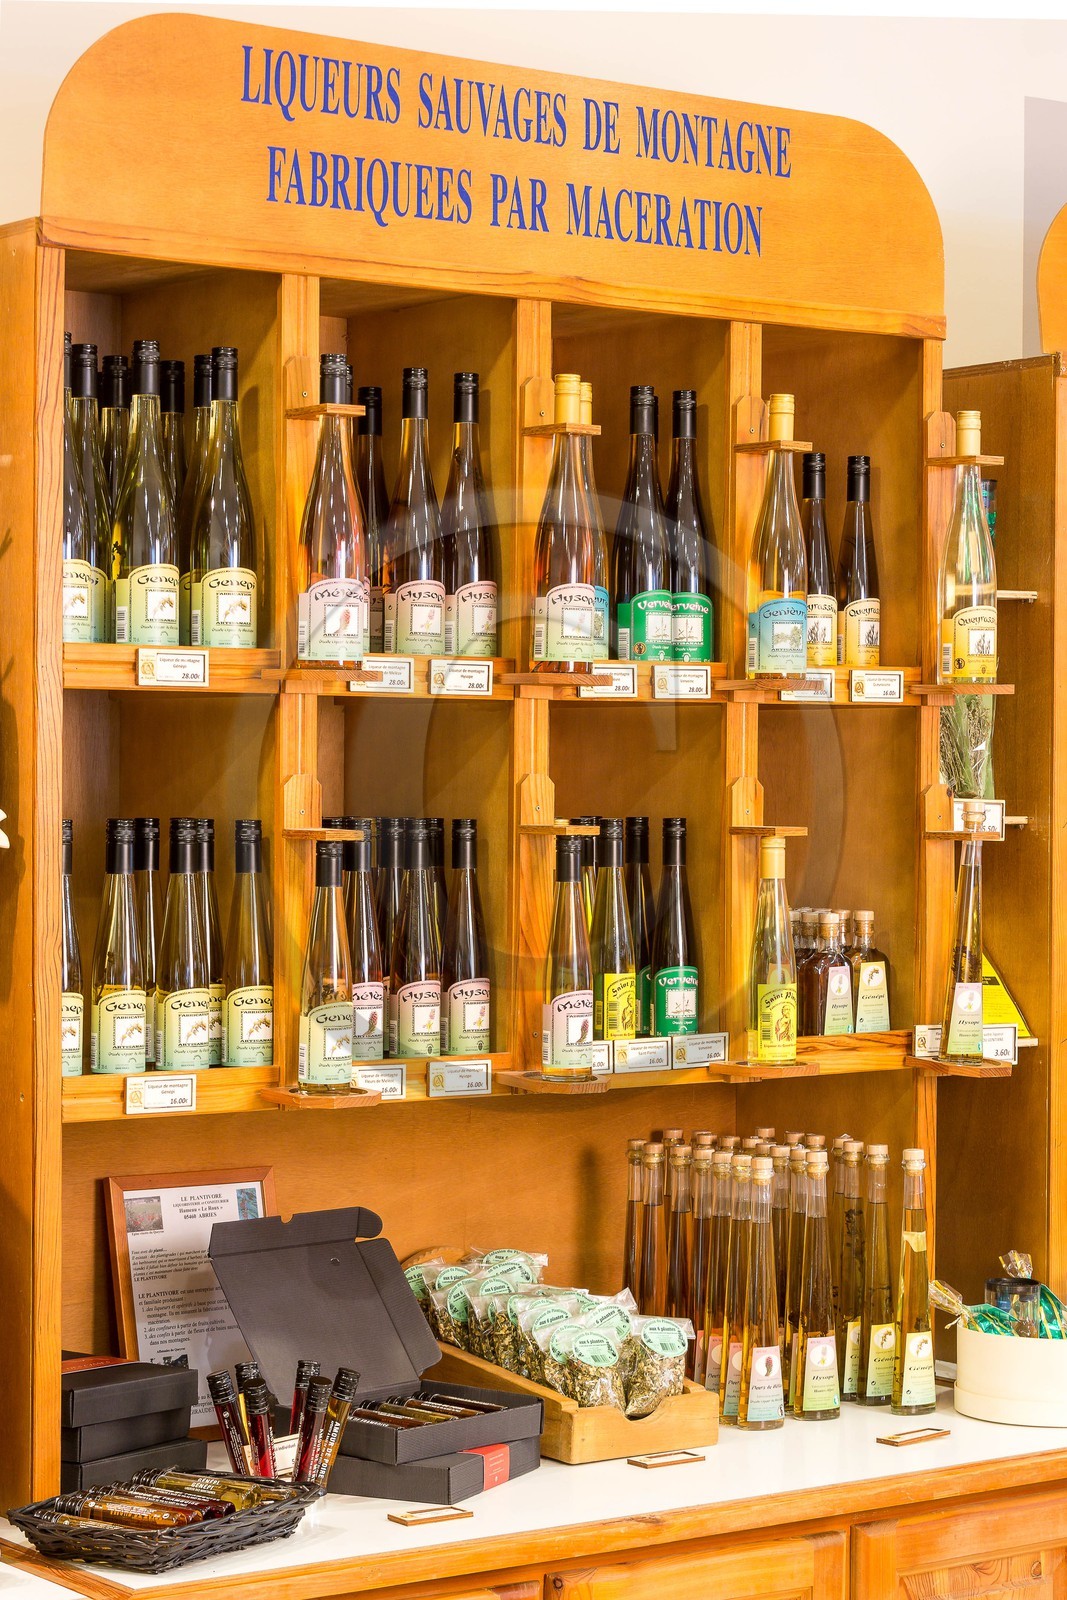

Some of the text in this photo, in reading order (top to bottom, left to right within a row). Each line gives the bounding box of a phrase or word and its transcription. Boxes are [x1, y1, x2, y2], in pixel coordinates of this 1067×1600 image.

[243, 46, 790, 177] LIQUEURS SAUVAGES DE MONTAGNE
[268, 147, 761, 256] FABRIQUEES PAR MACERATION
[138, 574, 179, 587] Genep
[637, 600, 672, 611] Verve
[671, 602, 709, 614] erveine
[763, 606, 807, 620] Genièvr
[658, 975, 698, 988] Vervein
[557, 999, 593, 1013] Mélè
[189, 1193, 223, 1202] PLANTIVORE
[146, 1290, 179, 1299] PLANTIVORE
[318, 1421, 341, 1479] AMOUR DE POIRE
